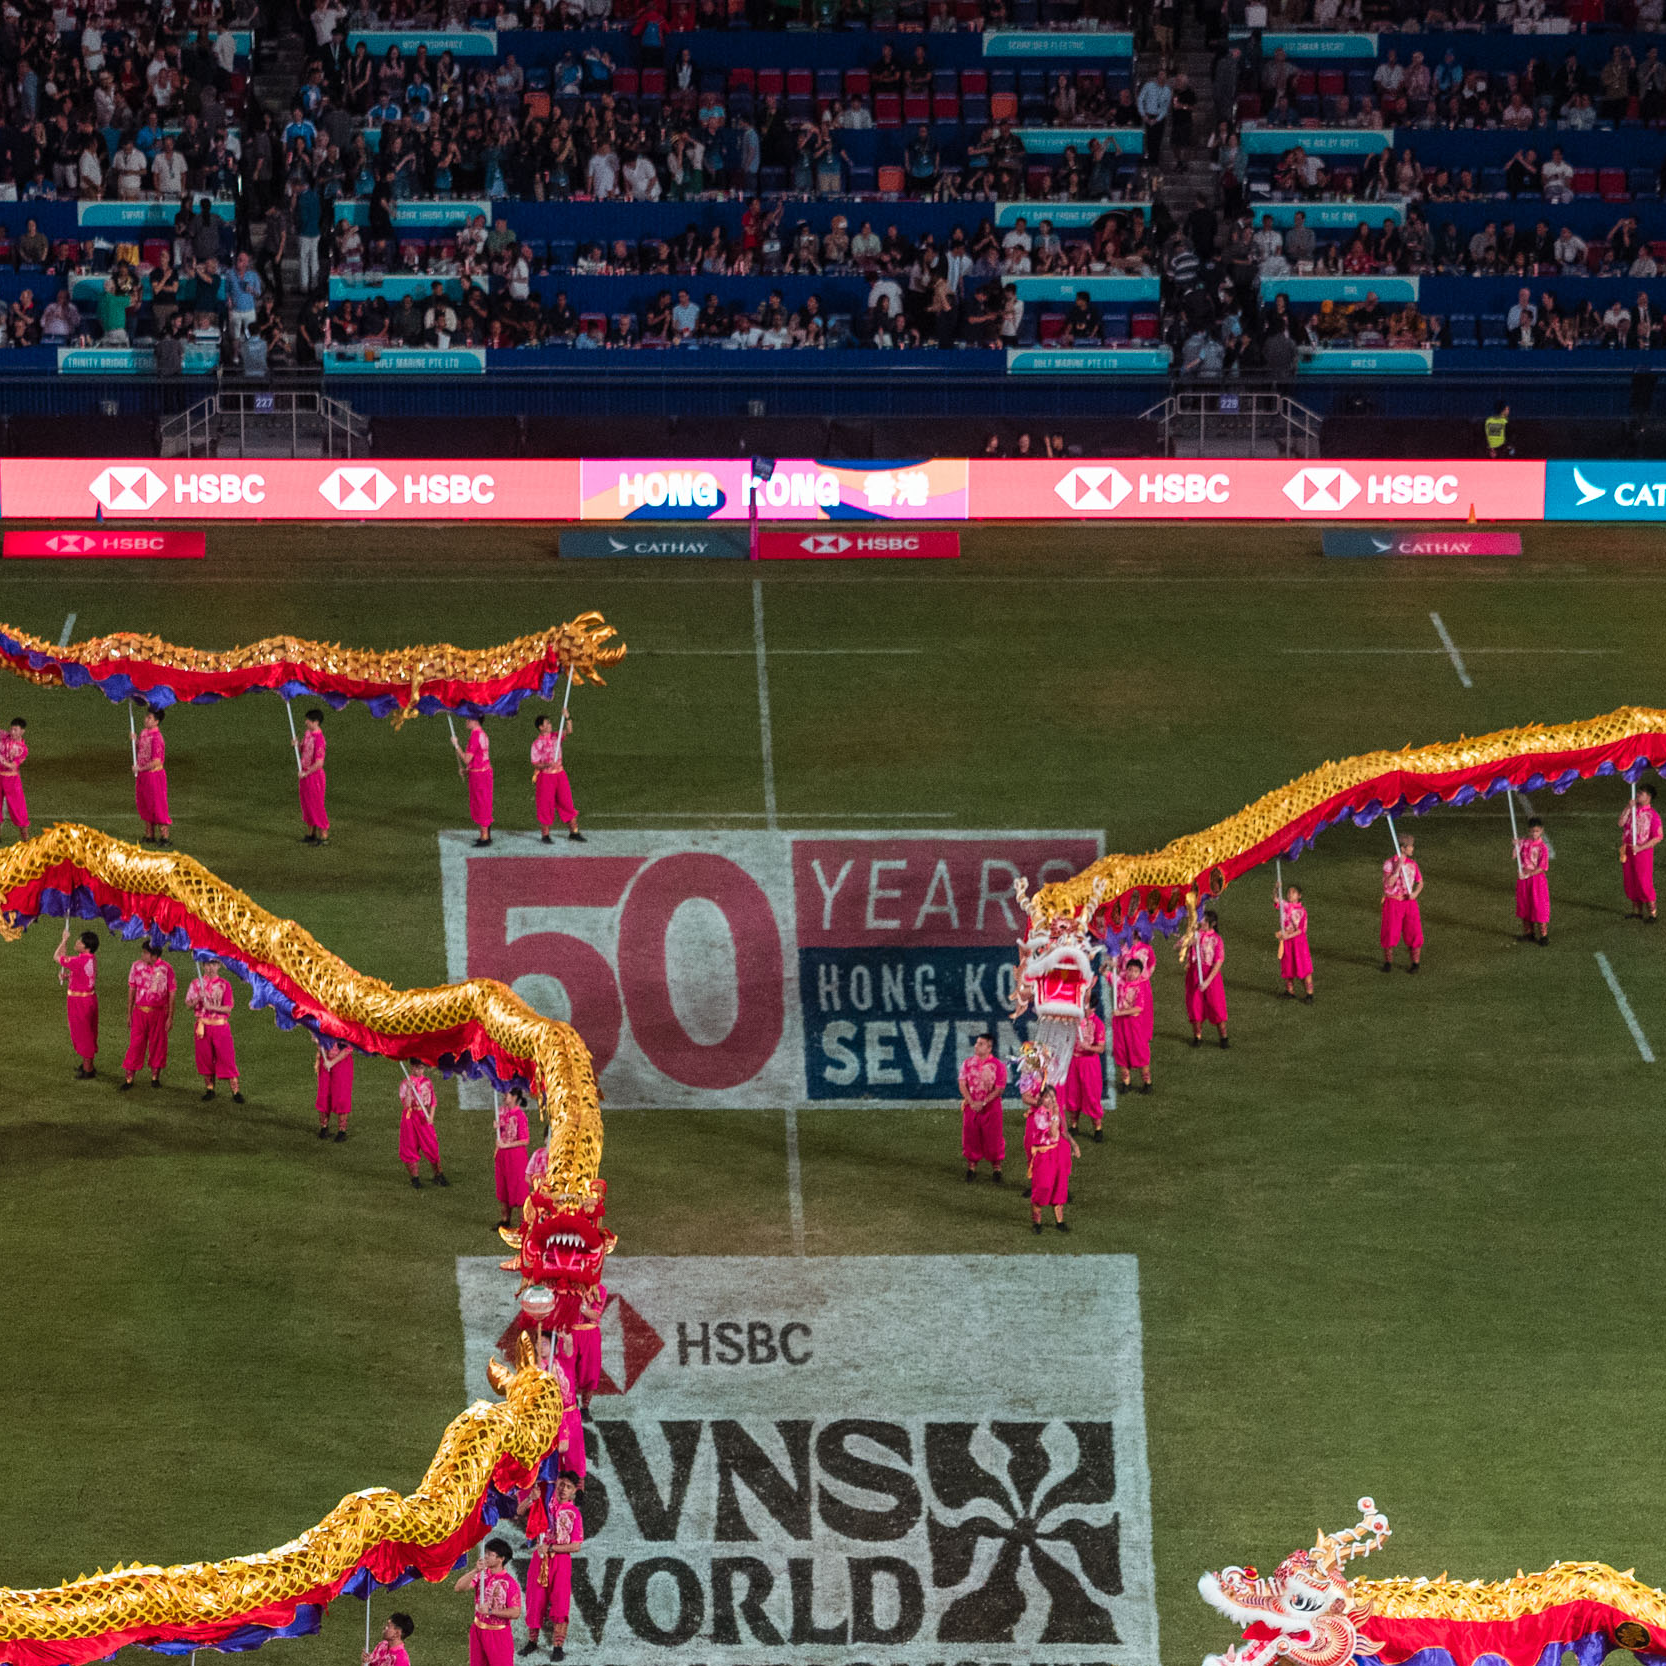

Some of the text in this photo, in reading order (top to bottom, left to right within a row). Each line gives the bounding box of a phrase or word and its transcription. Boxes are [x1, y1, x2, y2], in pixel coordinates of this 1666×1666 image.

[68, 357, 98, 368] TRINITY
[396, 358, 425, 369] MARINE
[429, 357, 443, 368] PTE
[445, 357, 459, 368] LTD
[1055, 358, 1084, 369] MARINE
[1087, 358, 1101, 369] PTE
[1103, 358, 1118, 369] LTD
[255, 397, 274, 409] 227
[174, 474, 266, 504] HSBC
[403, 474, 495, 504] HSBC
[618, 472, 840, 507] HONG KONG
[863, 472, 929, 507] 香港
[1139, 474, 1230, 504] HSBC
[1367, 475, 1458, 505] HSBC
[101, 537, 165, 551] HSBC
[633, 541, 710, 554] CATHAY
[856, 536, 920, 551] HSBC
[1397, 541, 1472, 554] CATHAY
[465, 852, 785, 1089] 50
[819, 963, 939, 1011] HONG
[677, 1321, 813, 1367] HSBC
